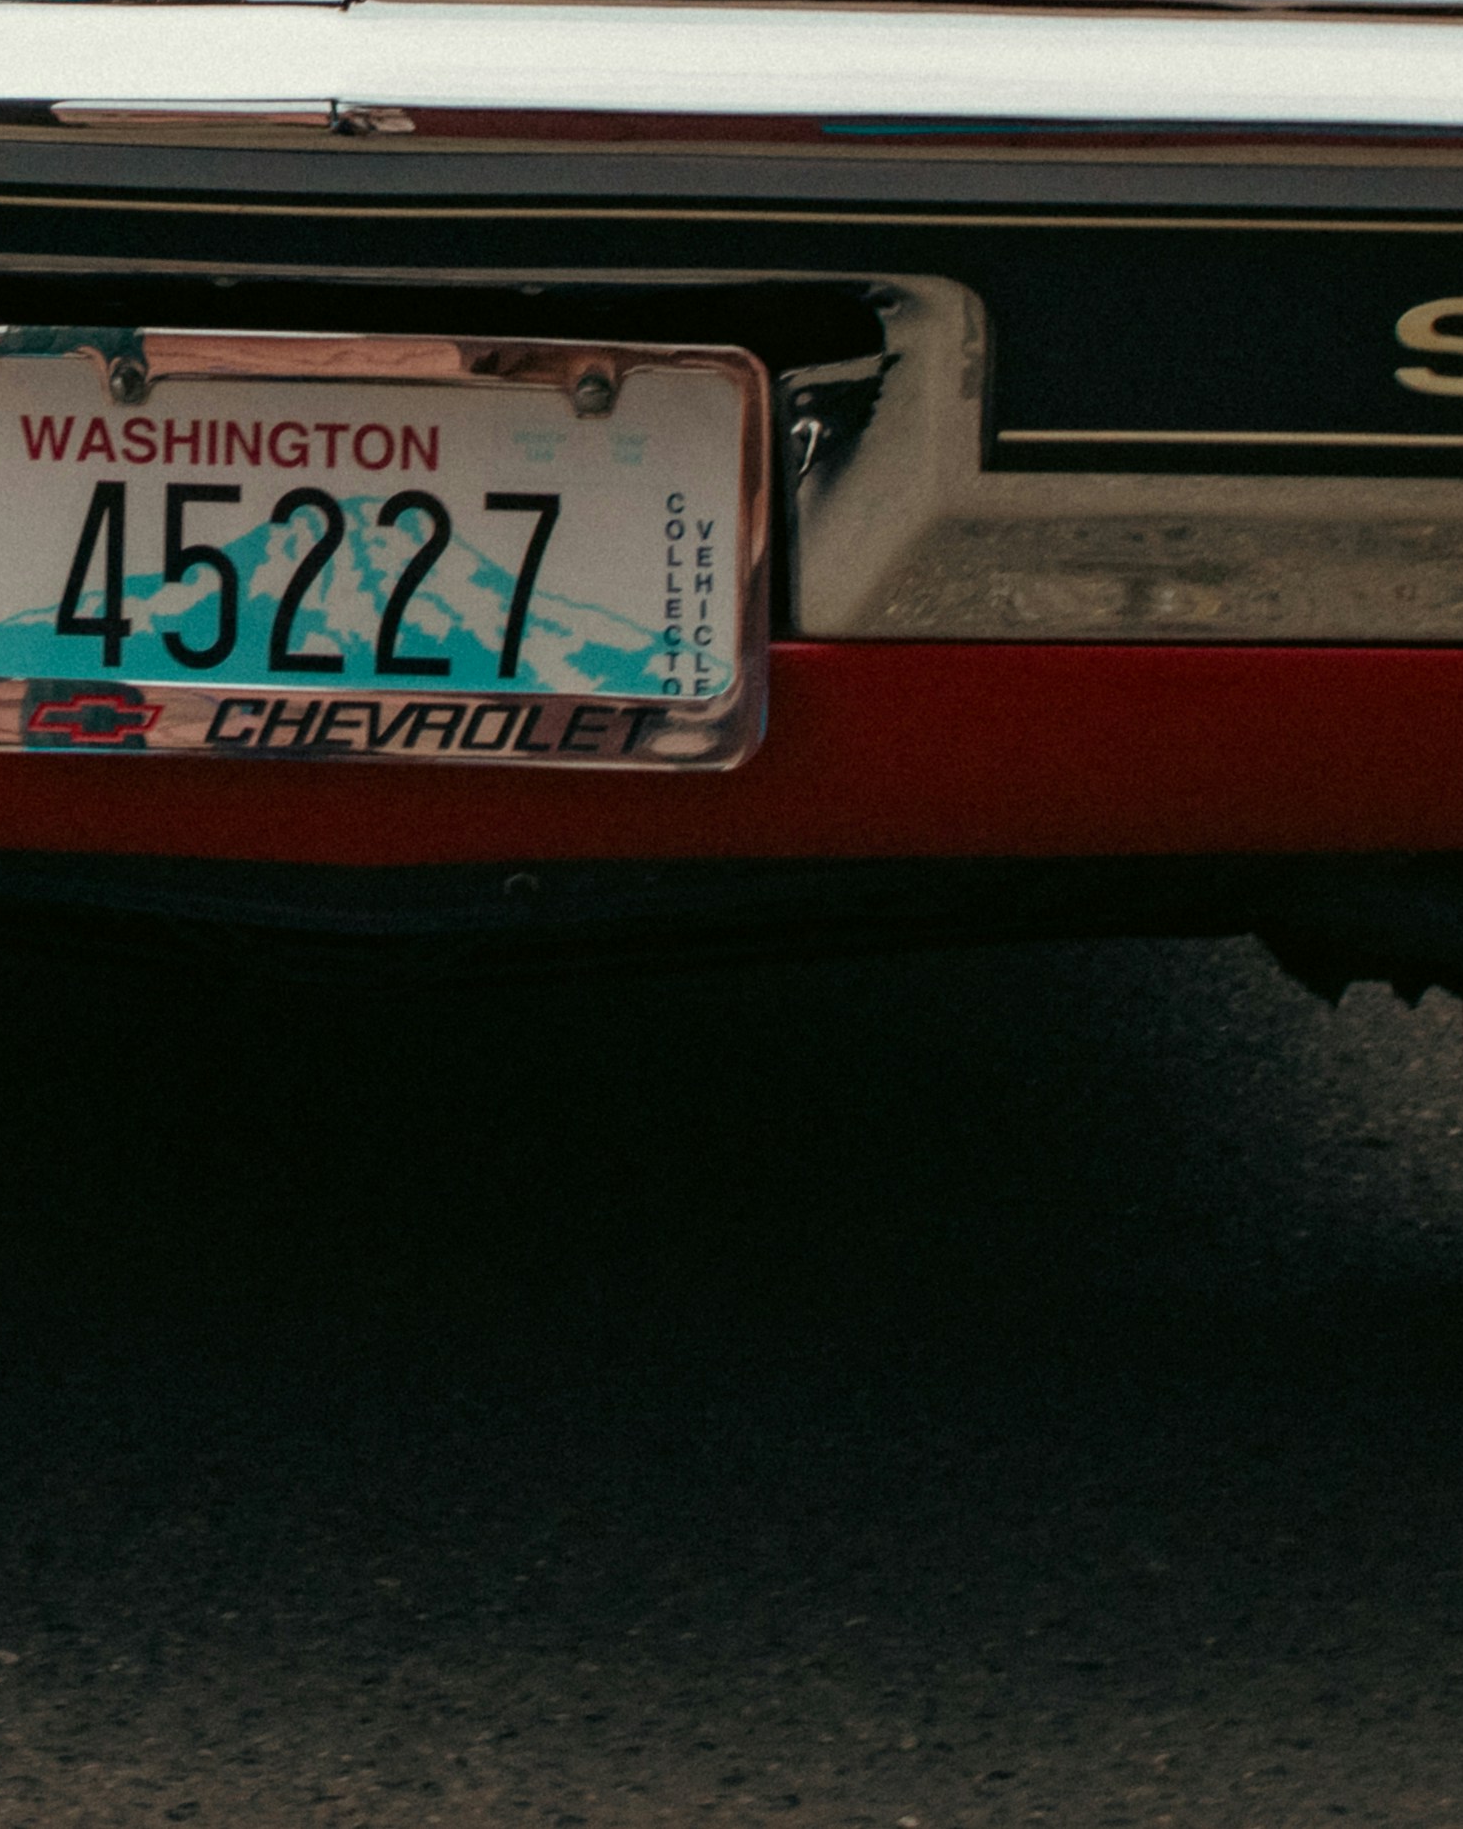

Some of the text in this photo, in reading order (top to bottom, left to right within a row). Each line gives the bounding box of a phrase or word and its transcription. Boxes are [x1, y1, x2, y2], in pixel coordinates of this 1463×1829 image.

[20, 414, 441, 471] WASHINGTON
[55, 480, 562, 680] 45227
[204, 697, 672, 755] CHEVROLET
